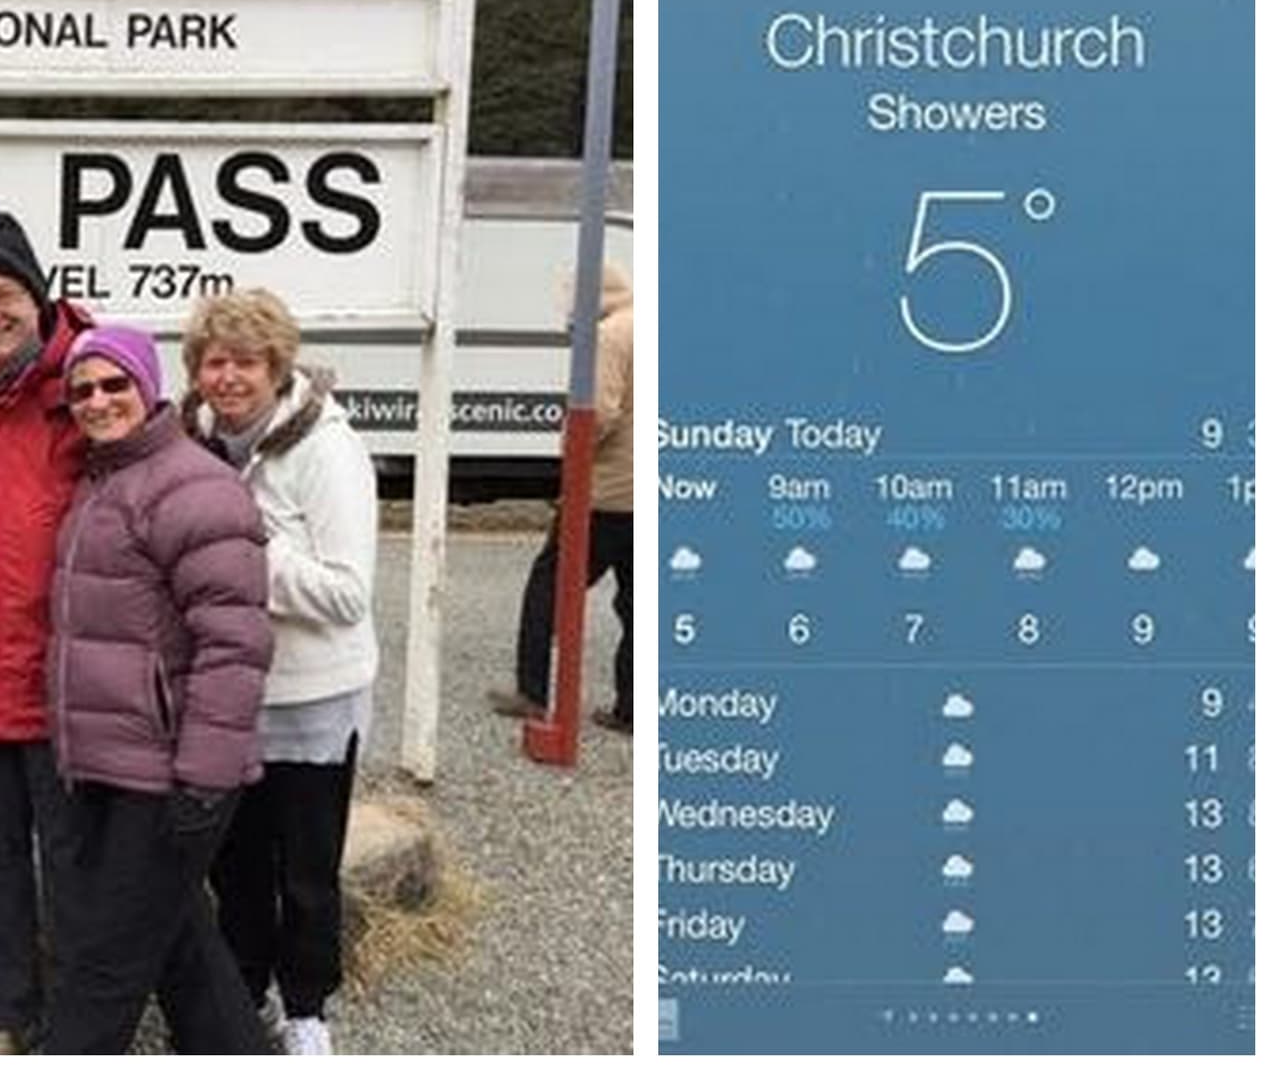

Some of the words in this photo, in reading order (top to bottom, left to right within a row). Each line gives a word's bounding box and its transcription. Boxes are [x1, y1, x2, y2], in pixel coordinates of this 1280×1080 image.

[127, 13, 236, 50] PARK
[767, 14, 1146, 69] Christchurch
[869, 94, 1047, 131] Showers
[57, 150, 383, 254] PASS
[44, 265, 110, 299] VEL
[128, 265, 234, 299] 737m
[347, 396, 563, 422] kiwircenic.co
[658, 418, 773, 455] Sunday
[785, 419, 883, 455] Today
[1202, 419, 1223, 448] 9
[658, 474, 717, 499] Now
[768, 474, 830, 500] 9am
[876, 474, 954, 500] 10am
[991, 474, 1067, 500] 11am
[1106, 474, 1183, 506] 12pm
[675, 615, 695, 644] 5
[789, 615, 810, 644] 6
[904, 615, 923, 643] 7
[1018, 615, 1040, 644] 8
[1132, 615, 1153, 644] 9
[658, 689, 778, 724] Monday
[1202, 689, 1223, 718] 9
[1185, 745, 1217, 771] 11
[658, 800, 835, 835] Wednesday
[1185, 799, 1222, 829] 13
[1185, 854, 1222, 883] 13
[1185, 910, 1222, 939] 13
